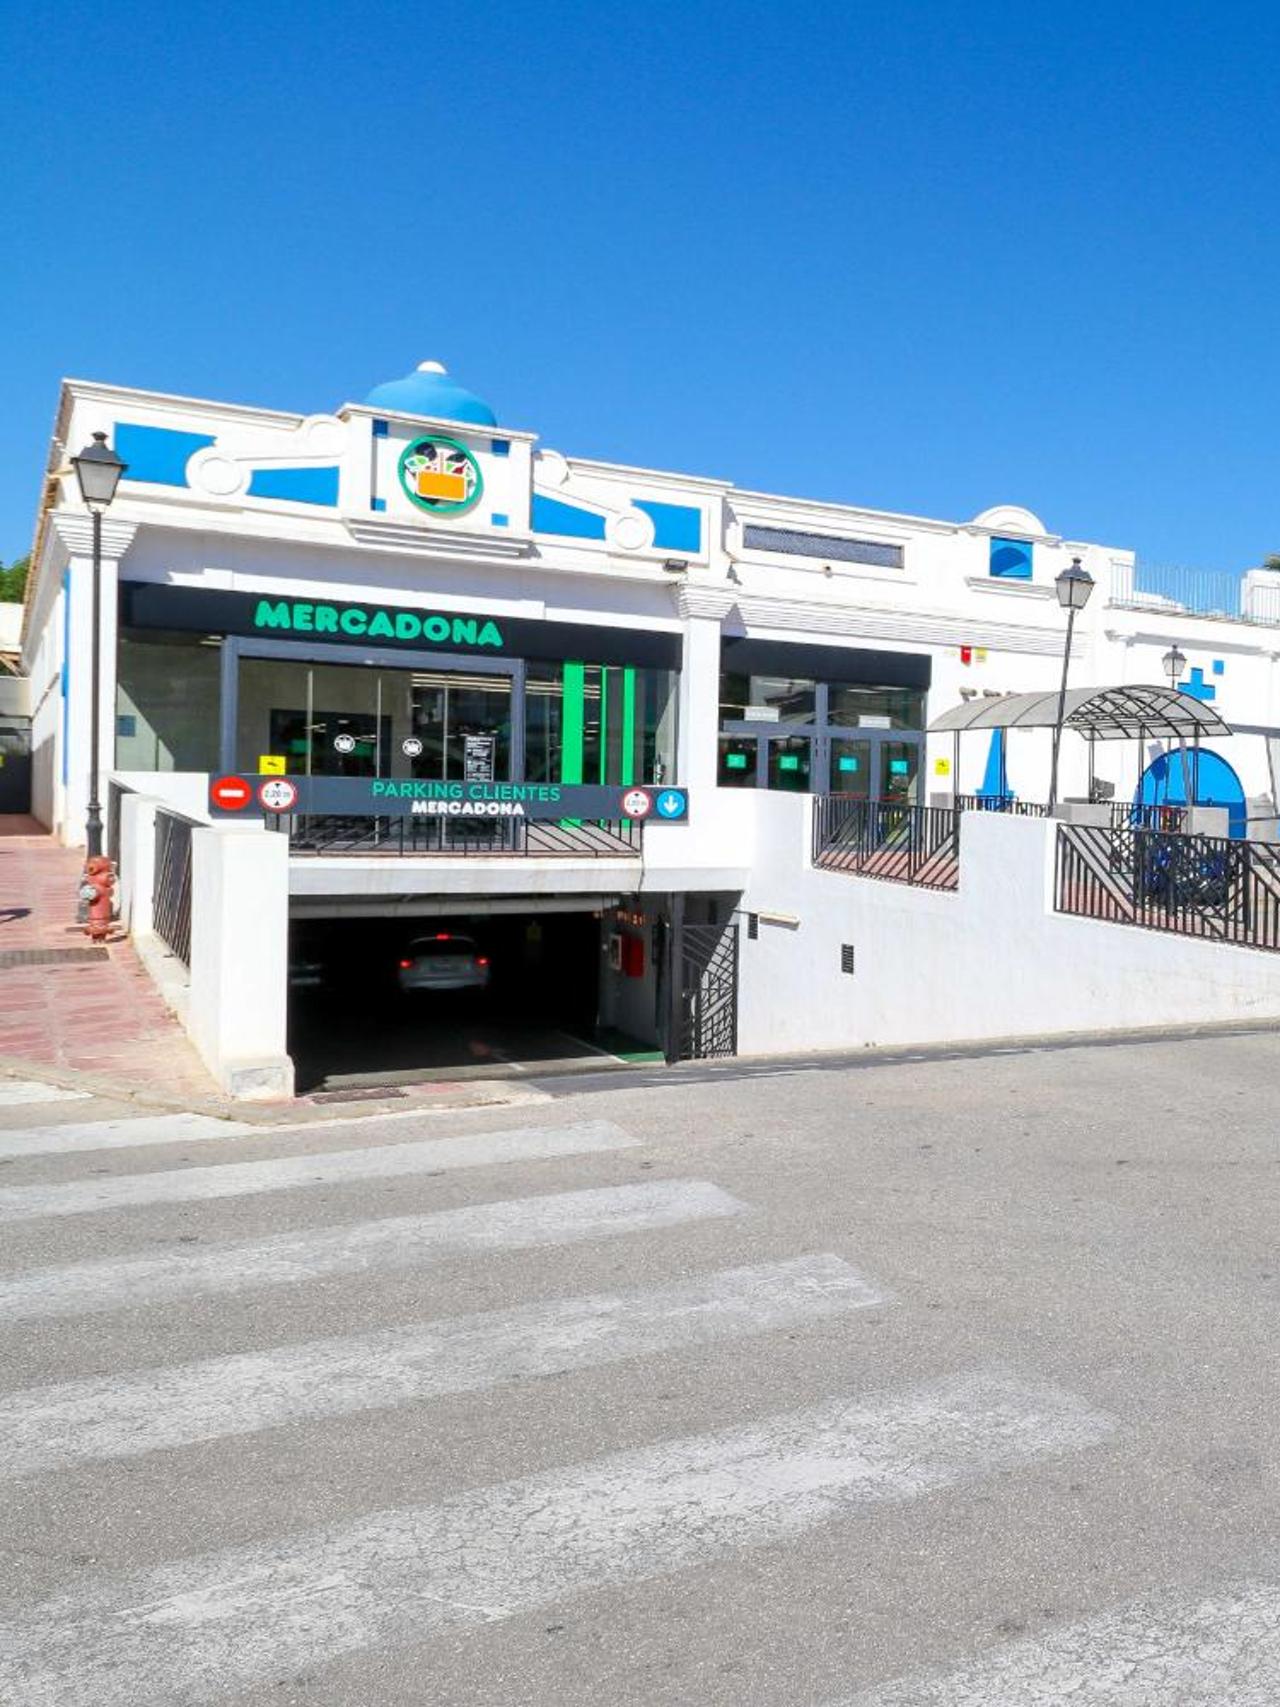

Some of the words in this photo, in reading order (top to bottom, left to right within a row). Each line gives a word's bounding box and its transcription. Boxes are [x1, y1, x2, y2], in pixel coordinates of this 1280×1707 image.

[255, 600, 503, 647] MERCADONA
[372, 781, 463, 798] PARKING
[469, 785, 561, 801] CLIENTES
[411, 800, 525, 815] MERCADONA
